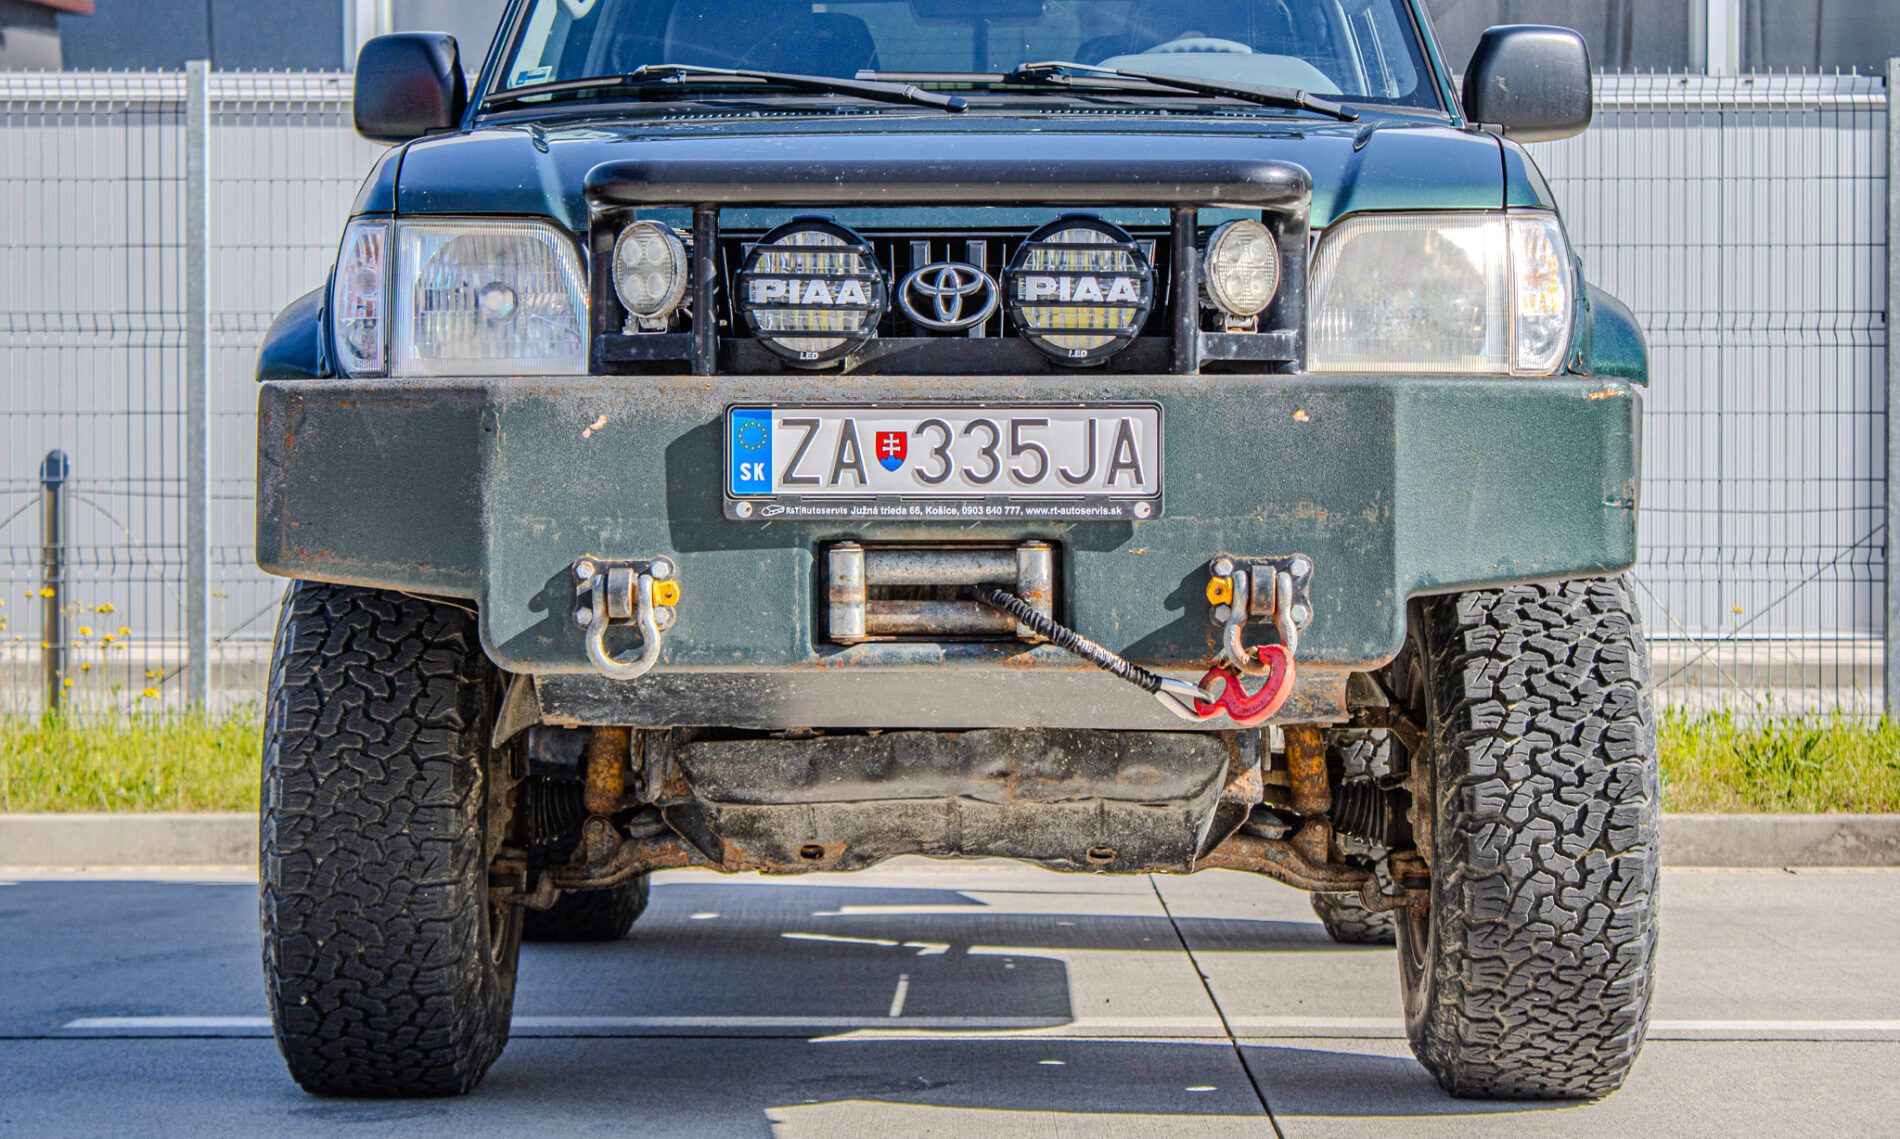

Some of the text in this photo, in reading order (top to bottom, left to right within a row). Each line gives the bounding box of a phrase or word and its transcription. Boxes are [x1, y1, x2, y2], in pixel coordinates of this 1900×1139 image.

[755, 279, 868, 304] PIAA
[1025, 276, 1139, 302] PIAA
[800, 351, 819, 360] LED
[781, 417, 1146, 486] ZA 335JA
[740, 462, 765, 481] SK
[850, 505, 879, 517] Južná
[880, 505, 907, 515] trieda
[909, 505, 923, 517] 66,
[925, 505, 960, 517] Košice,
[962, 505, 984, 515] 0903
[986, 505, 1002, 515] 640
[1004, 505, 1024, 517] 777,
[1025, 505, 1123, 516] www.rt-autoservis.sk
